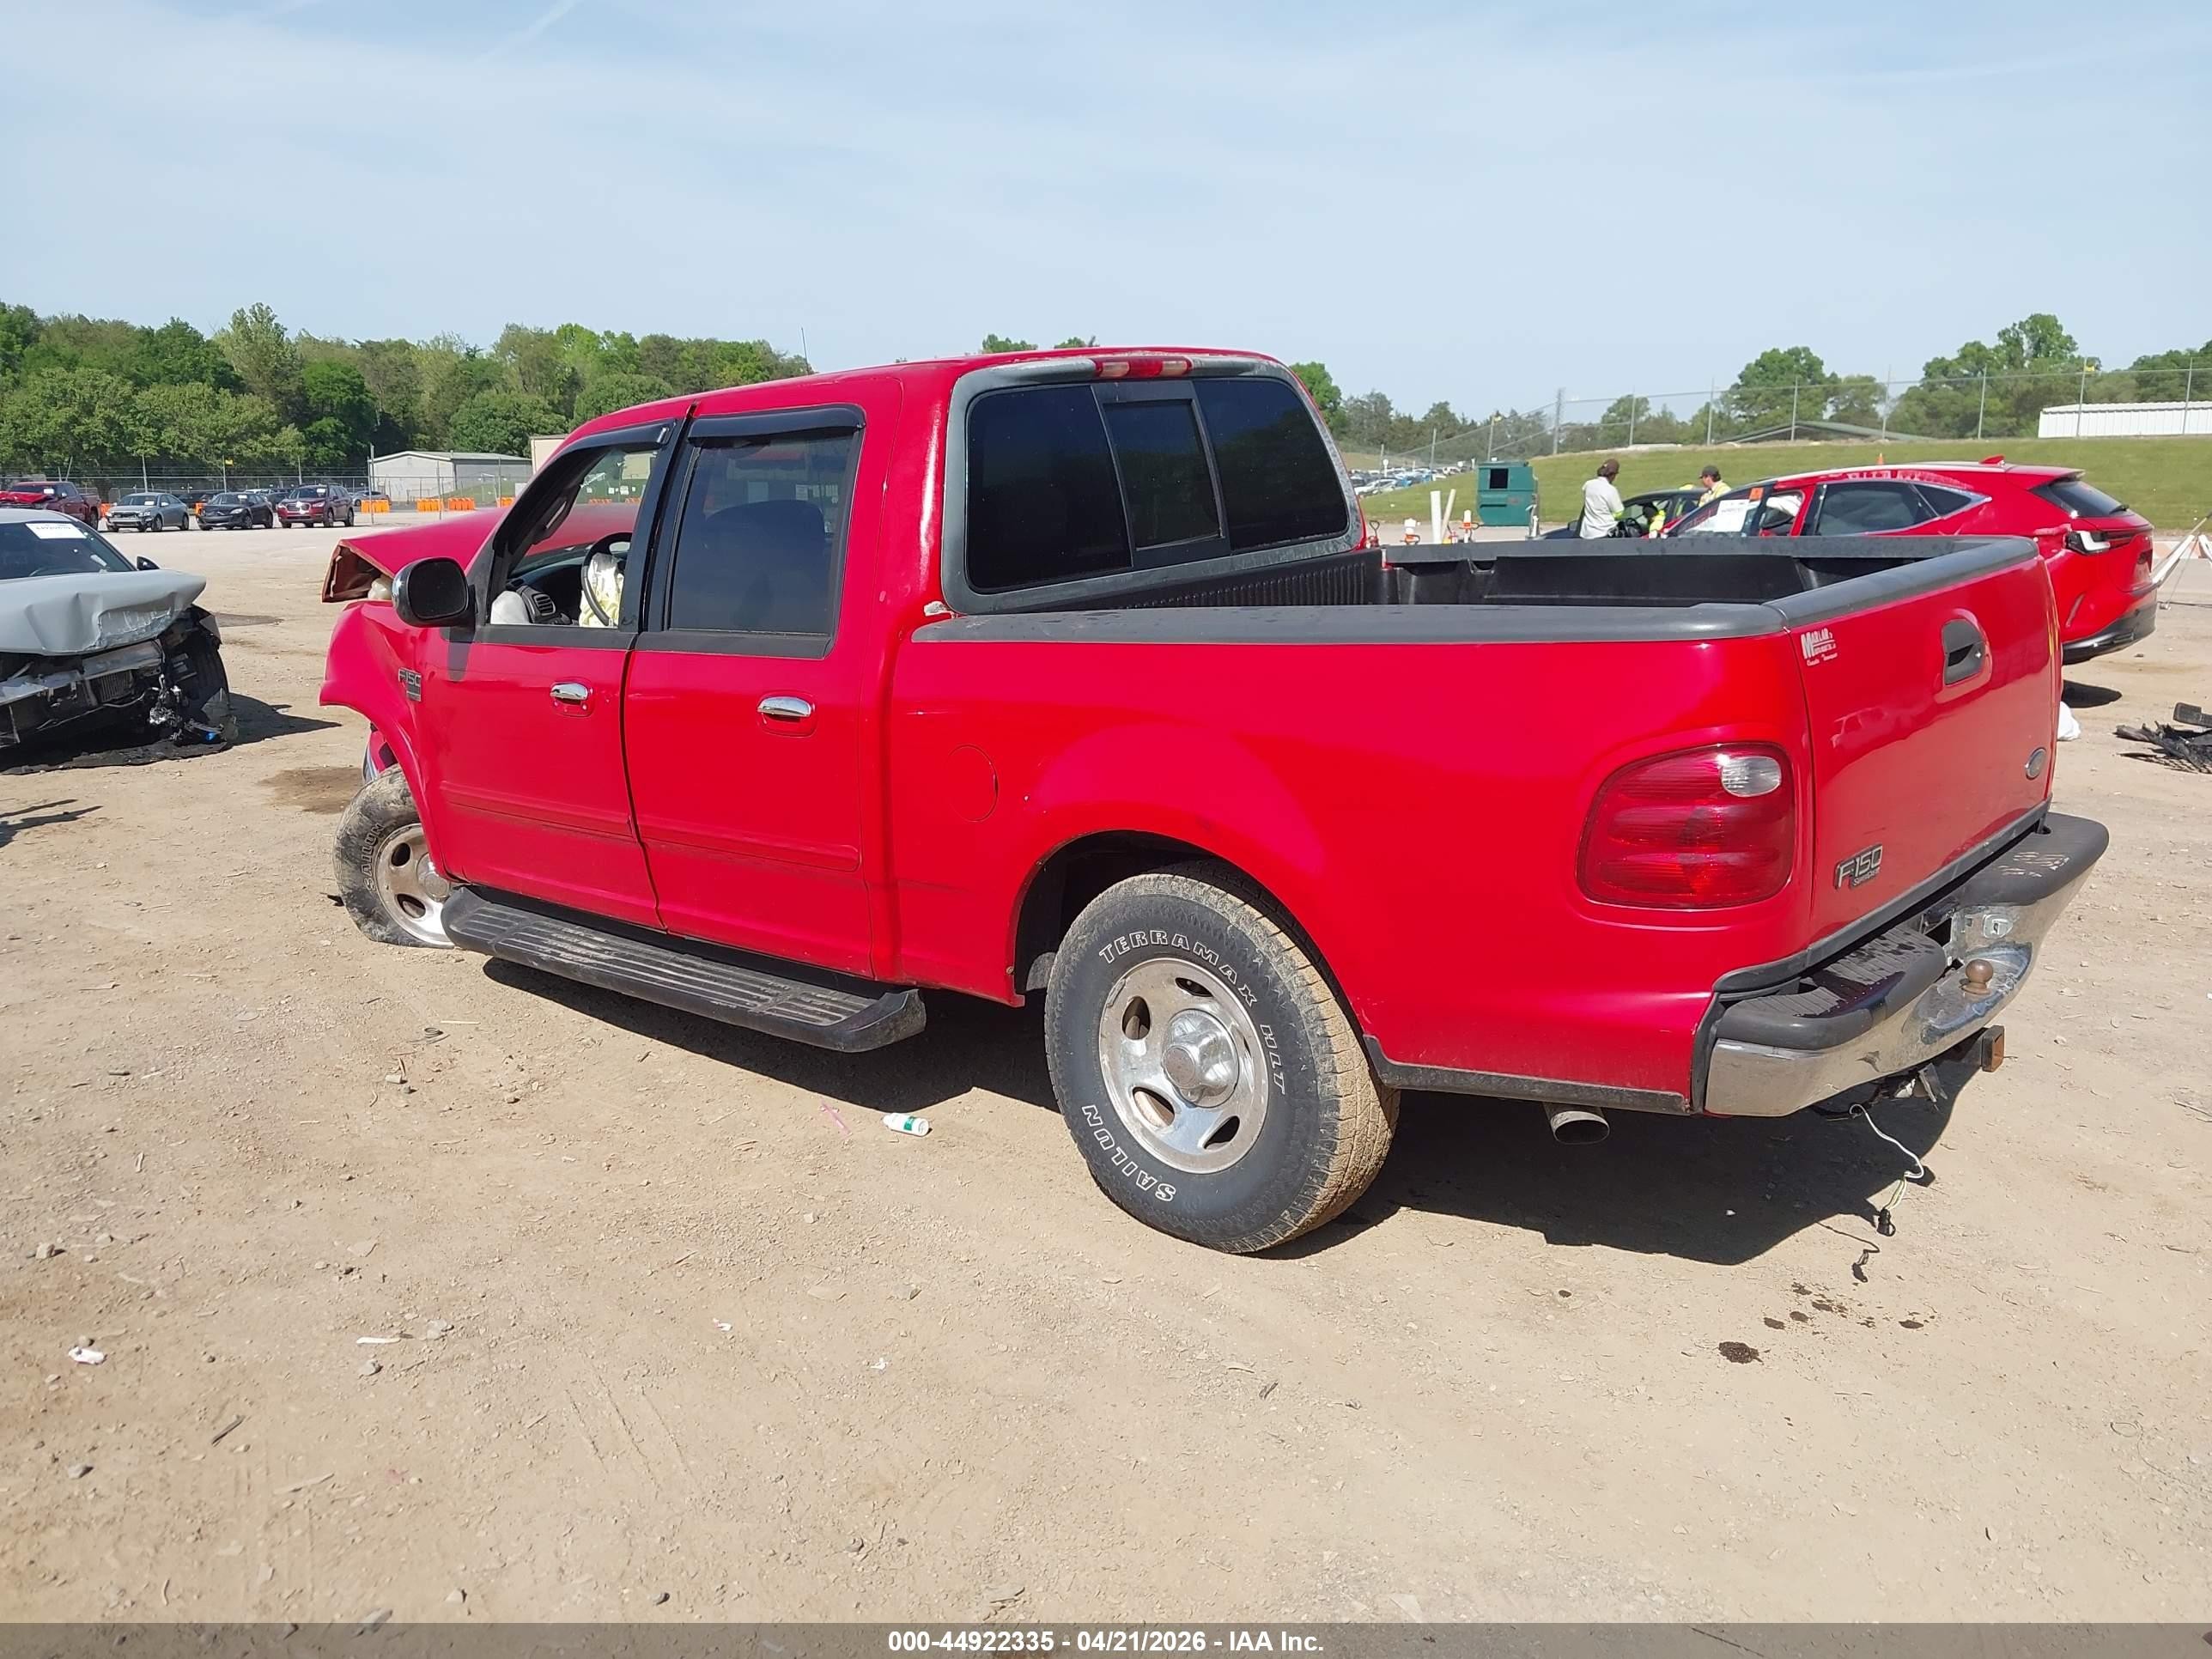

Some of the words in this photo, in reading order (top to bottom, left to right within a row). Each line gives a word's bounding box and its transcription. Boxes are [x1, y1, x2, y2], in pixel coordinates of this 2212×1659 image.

[361, 823, 386, 891] SAILUN
[1099, 930, 1256, 1006] TERRAMAX
[1081, 1104, 1176, 1202] SAILUN
